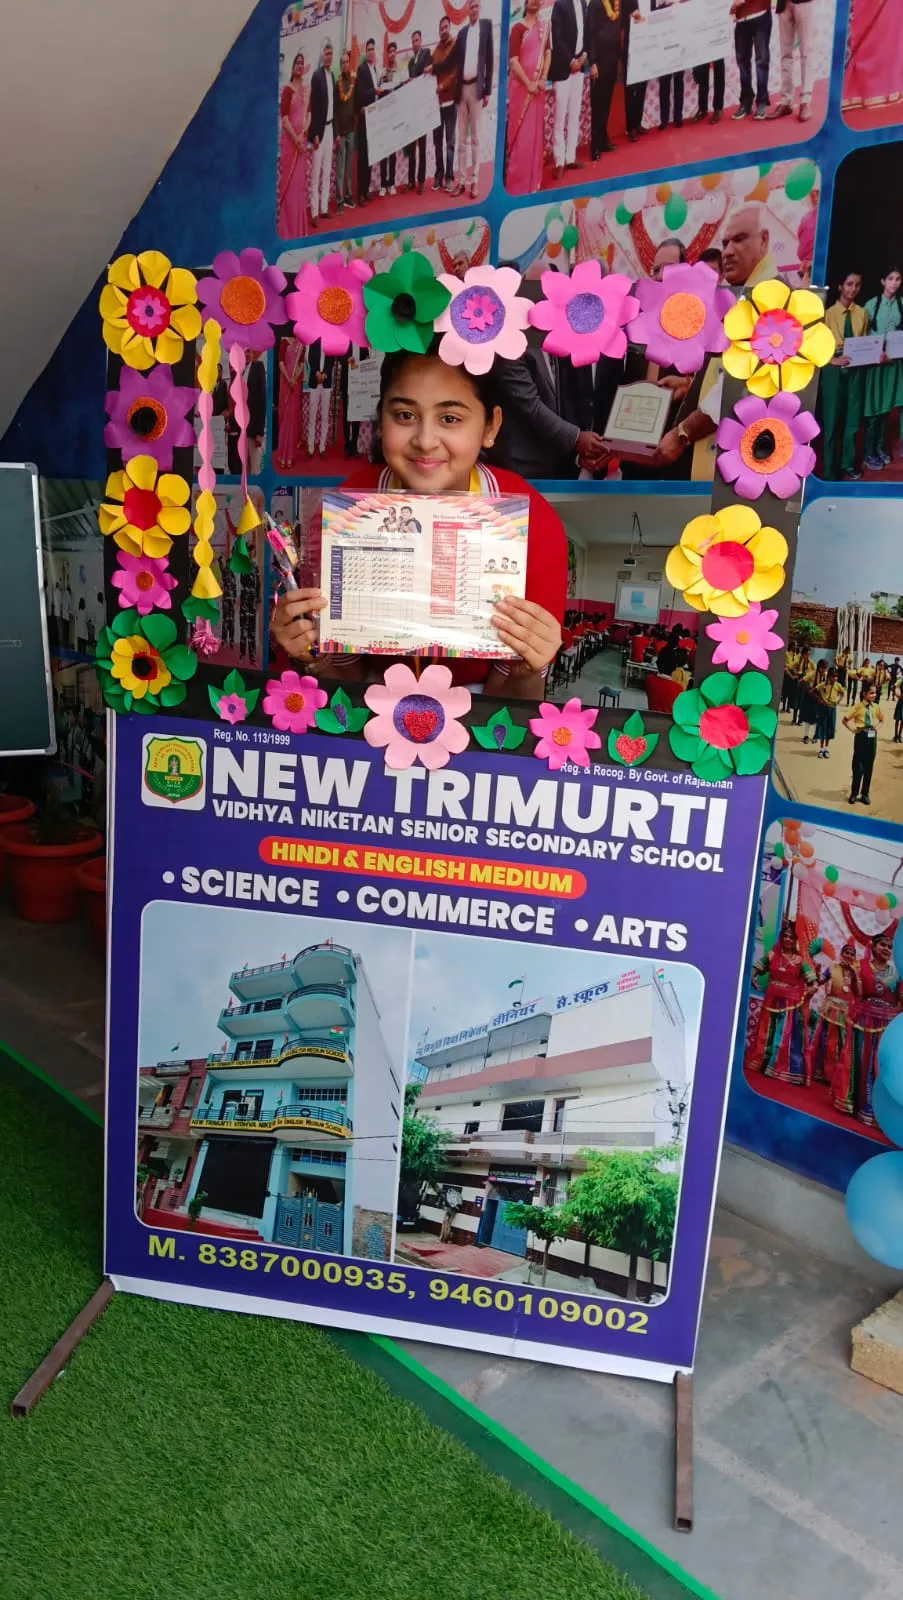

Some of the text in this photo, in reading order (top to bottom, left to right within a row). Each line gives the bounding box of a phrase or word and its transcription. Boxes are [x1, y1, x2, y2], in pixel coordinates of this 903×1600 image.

[213, 728, 290, 745] Reg. No. 113/1999
[212, 747, 371, 809] NEW
[384, 766, 728, 848] TRIMURTI
[560, 762, 581, 774] Reg.
[593, 766, 626, 780] Recog.
[628, 769, 641, 782] By
[644, 771, 670, 784] Govt.
[672, 775, 683, 785] of
[212, 799, 724, 873] VIDHYA NIKETAN SENIOR SECONDARY SCHOOL
[271, 841, 573, 893] HINDI & ENGLISH MEDIUM
[492, 1003, 537, 1027] सीनियर
[573, 981, 611, 1004] स्कूल
[147, 1235, 650, 1335] M. 8387000935, 9460109002
